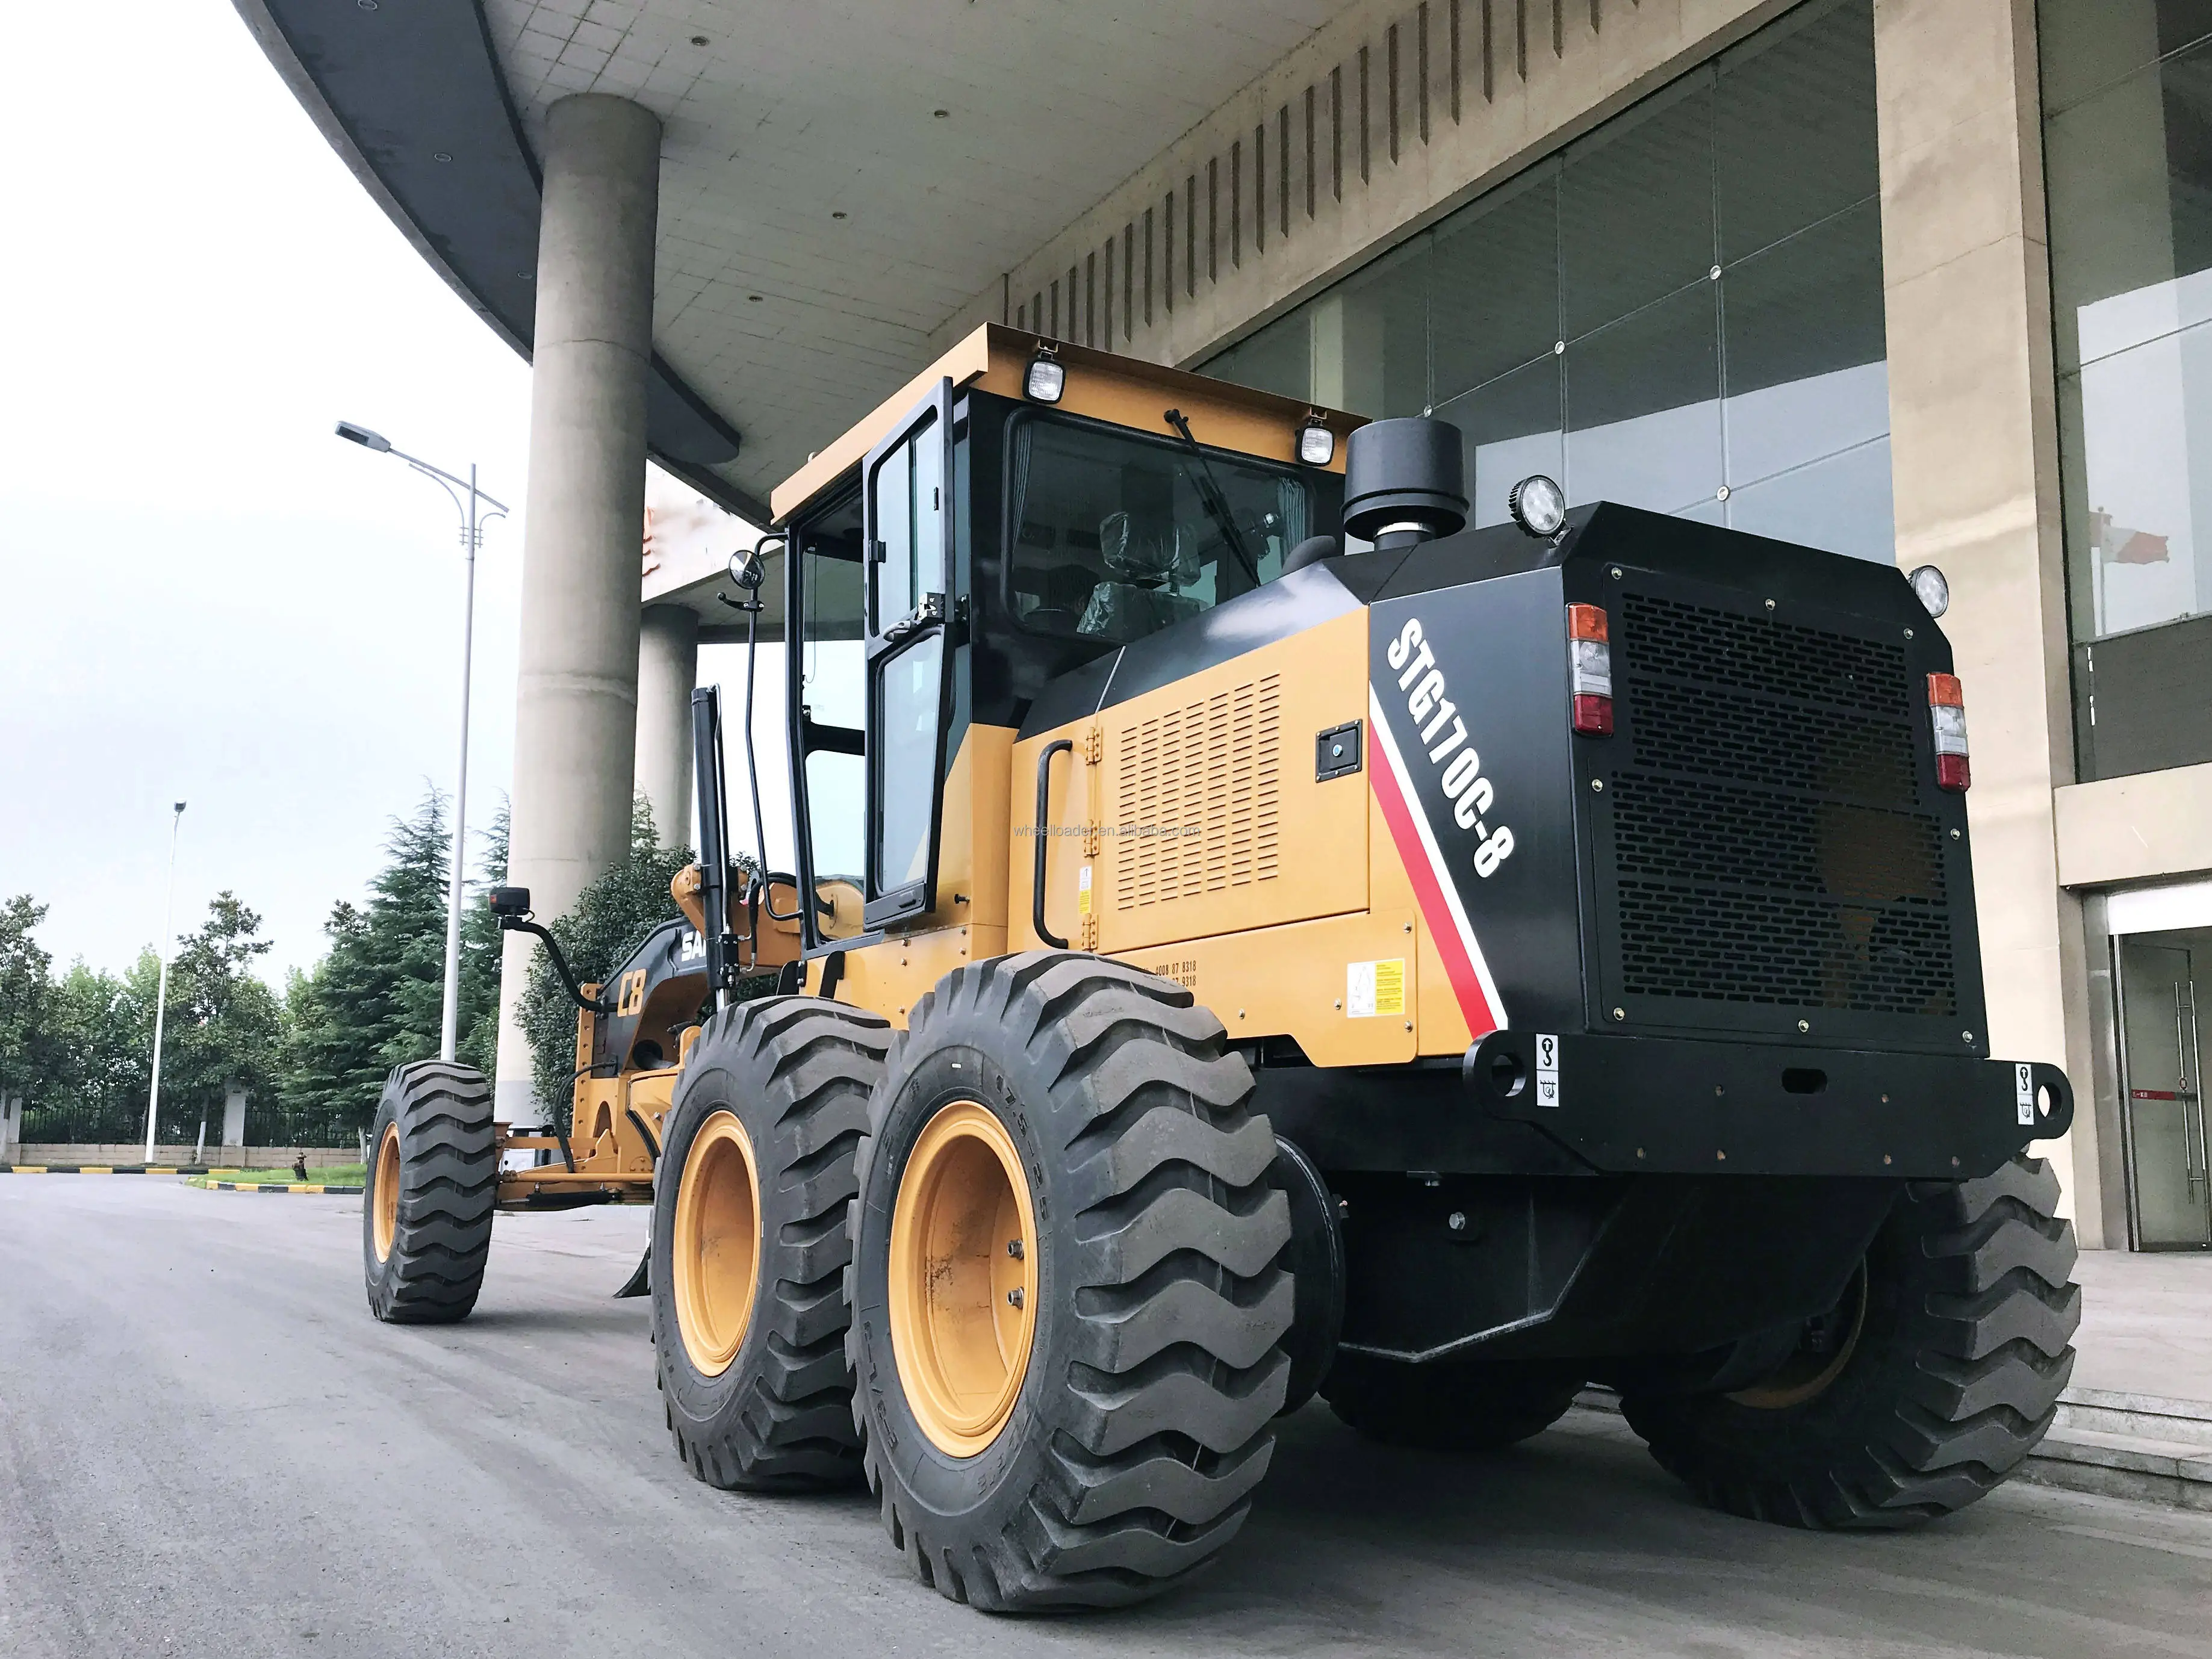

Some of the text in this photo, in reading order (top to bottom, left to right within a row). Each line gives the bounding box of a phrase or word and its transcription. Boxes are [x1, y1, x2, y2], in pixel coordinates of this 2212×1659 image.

[1387, 618, 1514, 878] STG170C-8
[1172, 963, 1179, 974] 87
[1182, 960, 1196, 973] 8318
[1182, 975, 1196, 987] 9318
